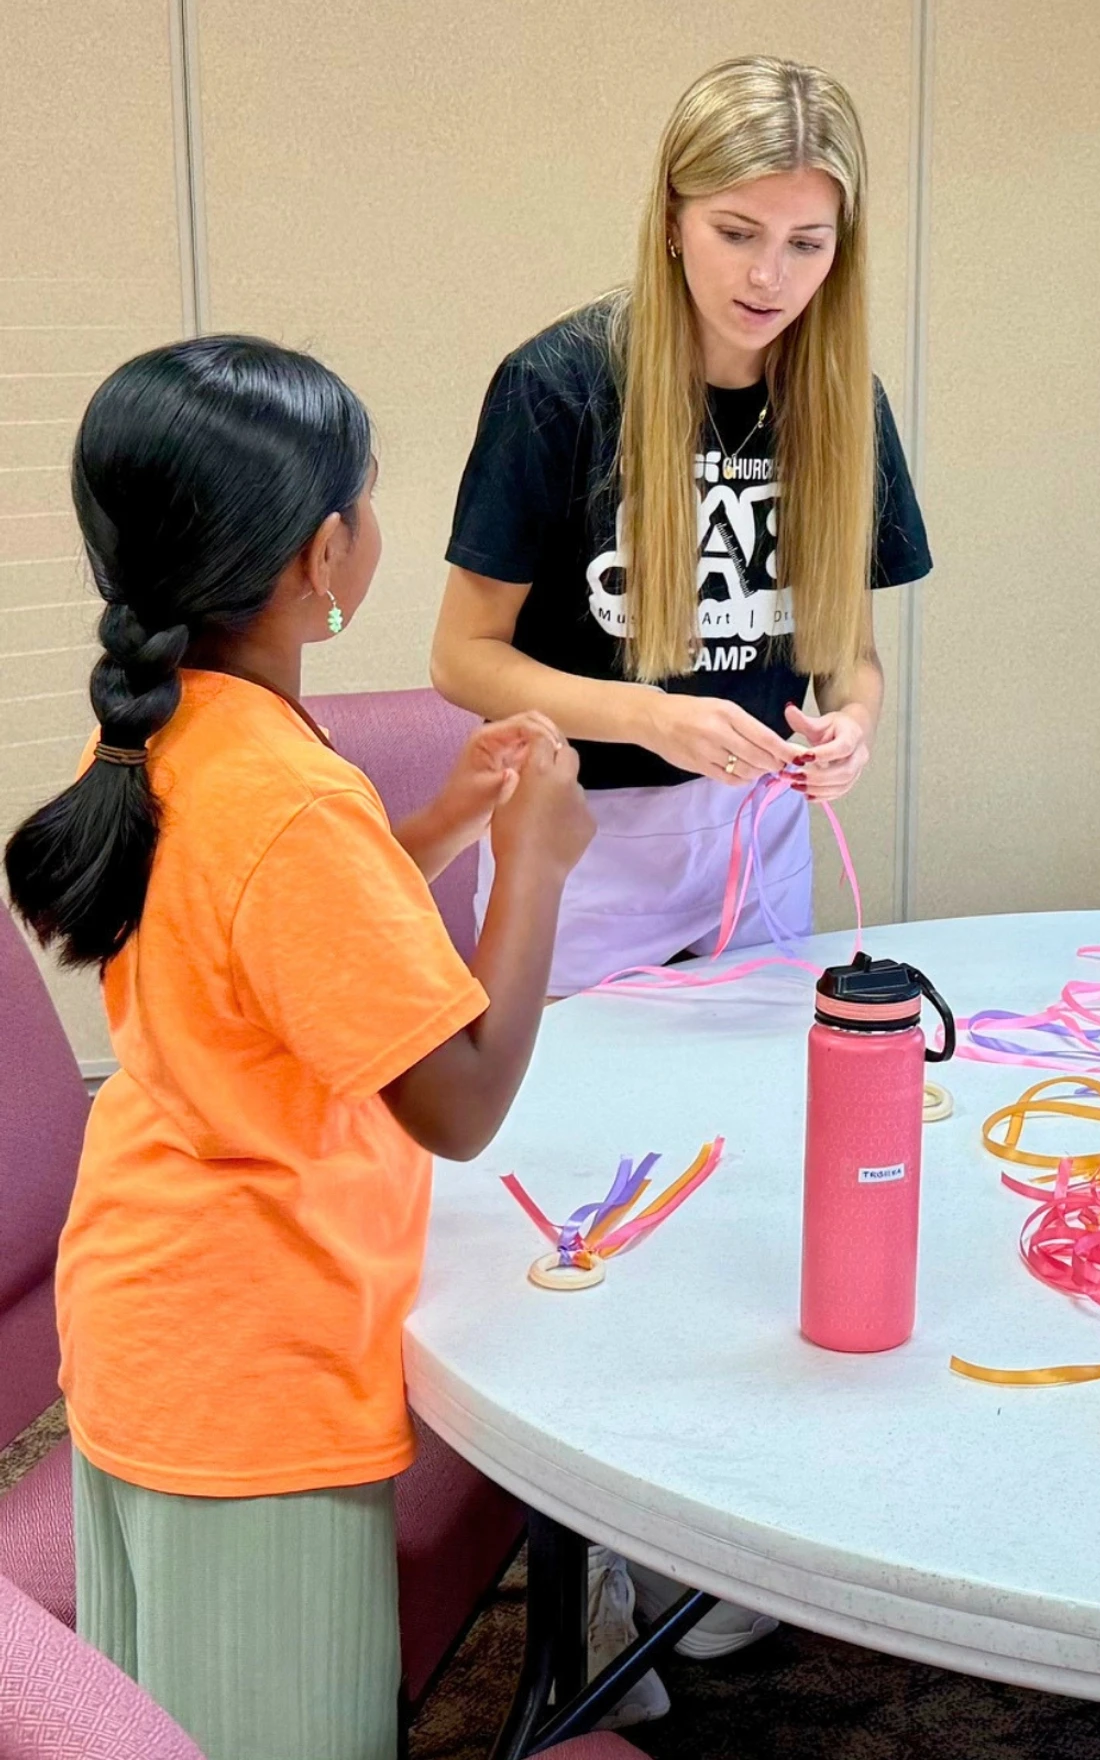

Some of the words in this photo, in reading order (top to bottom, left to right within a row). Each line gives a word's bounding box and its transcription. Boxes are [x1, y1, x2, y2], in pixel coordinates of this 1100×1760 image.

[722, 457, 775, 480] CHURC
[702, 612, 730, 625] Art
[686, 645, 757, 672] AMP
